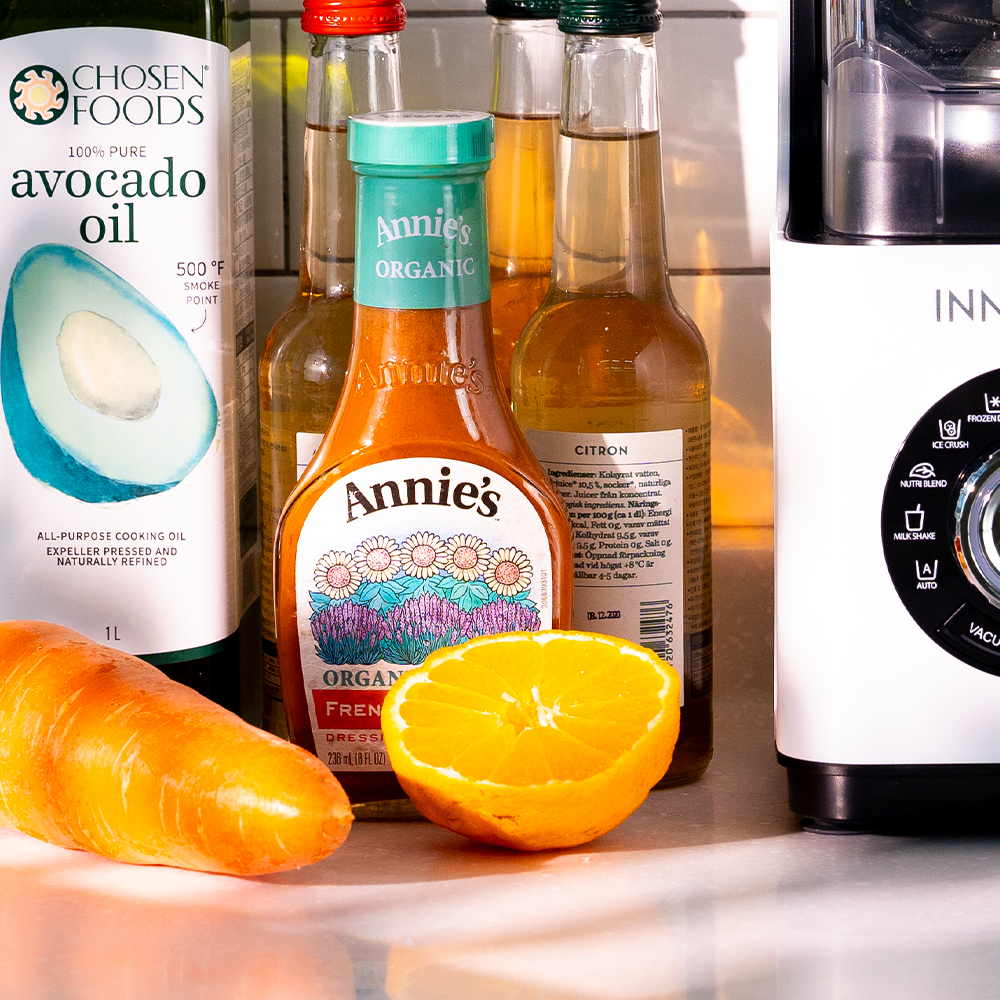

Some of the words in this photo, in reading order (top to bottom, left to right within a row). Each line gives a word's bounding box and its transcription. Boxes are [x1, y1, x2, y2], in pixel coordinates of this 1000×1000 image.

[72, 95, 205, 126] FOODS
[68, 146, 105, 158] 100%
[109, 146, 147, 158] PURE
[11, 156, 206, 198] avocado
[79, 202, 139, 244] oil
[376, 206, 472, 248] Annie's
[176, 261, 206, 277] 500
[375, 258, 475, 279] ORGANIC
[183, 281, 220, 291] SMOKE
[186, 295, 218, 305] POINT
[967, 414, 997, 423] FROZEN
[932, 441, 944, 449] ICE
[944, 440, 969, 449] CRUSH
[574, 445, 628, 456] CITRON
[599, 470, 633, 480] Kolsyrat
[638, 479, 672, 488] naturliga
[900, 480, 923, 488] NUTRI
[923, 480, 947, 488] BLEND
[345, 466, 501, 524] Annie's
[573, 490, 600, 499] Juicer
[600, 490, 618, 499] från
[577, 512, 591, 520] per
[647, 507, 672, 518] Energi
[590, 520, 607, 529] Fett
[37, 532, 112, 541] ALL-PURPOSE
[115, 532, 165, 541] COOKING
[168, 532, 187, 541] OIL
[575, 530, 615, 541] Kolhydrat
[894, 532, 912, 540] MILK
[912, 532, 936, 540] SHAKE
[598, 541, 629, 550] Protein
[645, 539, 660, 548] Salt
[46, 546, 100, 556] EXPELLER
[103, 546, 152, 556] PRESSED
[155, 546, 178, 556] AND
[584, 550, 617, 561] Öppnad
[618, 549, 666, 560] förpackning
[57, 557, 118, 566] NATURALLY
[121, 557, 168, 566] REFINED
[585, 561, 599, 569] vid
[600, 561, 622, 571] högst
[645, 560, 655, 568] är
[917, 581, 937, 590] AUTO
[322, 669, 404, 687] ORGAN
[326, 701, 381, 717] FREN
[327, 751, 342, 766] 236
[364, 752, 373, 765] FL
